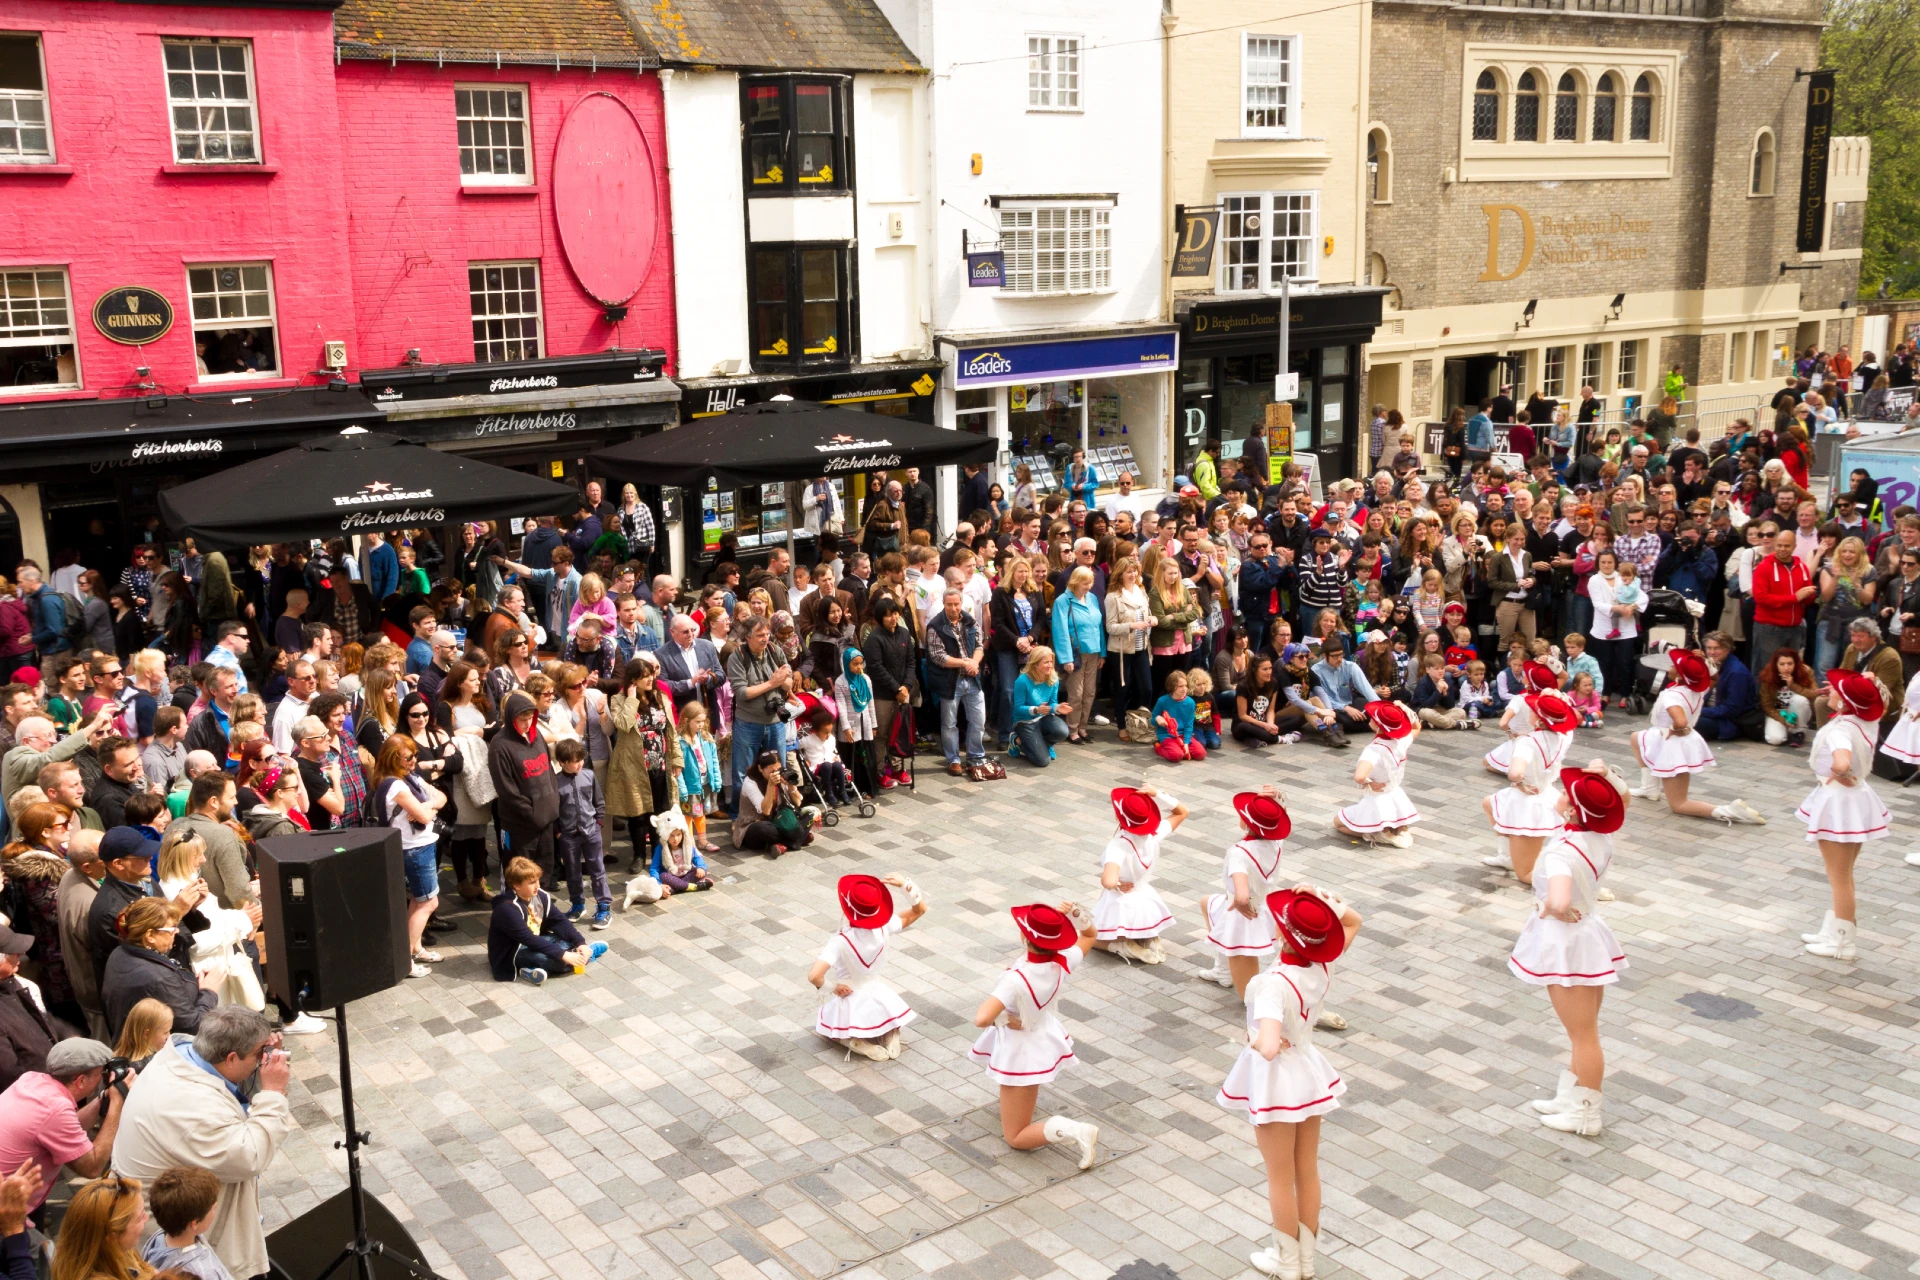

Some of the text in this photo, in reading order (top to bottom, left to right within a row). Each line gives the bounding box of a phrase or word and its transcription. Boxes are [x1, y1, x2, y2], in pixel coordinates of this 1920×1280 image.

[1812, 87, 1830, 106] D
[1804, 125, 1827, 239] Brighton Dome
[1180, 217, 1212, 252] D
[1542, 213, 1651, 243] Brighton Dome
[1477, 203, 1535, 282] D
[1179, 254, 1206, 265] Brighton
[1540, 241, 1647, 264] Studio Theatre
[972, 266, 999, 278] Leaders
[1177, 264, 1196, 272] Dome
[107, 313, 163, 328] GUINNESS
[1195, 315, 1208, 332] D
[1212, 316, 1249, 332] Brighton
[1250, 313, 1275, 326] Dome
[633, 371, 656, 380] Heineken
[964, 357, 1012, 376] Leaders
[376, 392, 403, 401] Heineken
[706, 387, 746, 413] Halls
[832, 387, 897, 400] www.halls-estate.com
[1184, 407, 1206, 437] D
[814, 439, 893, 453] Heineken
[332, 488, 434, 506] Heineken
